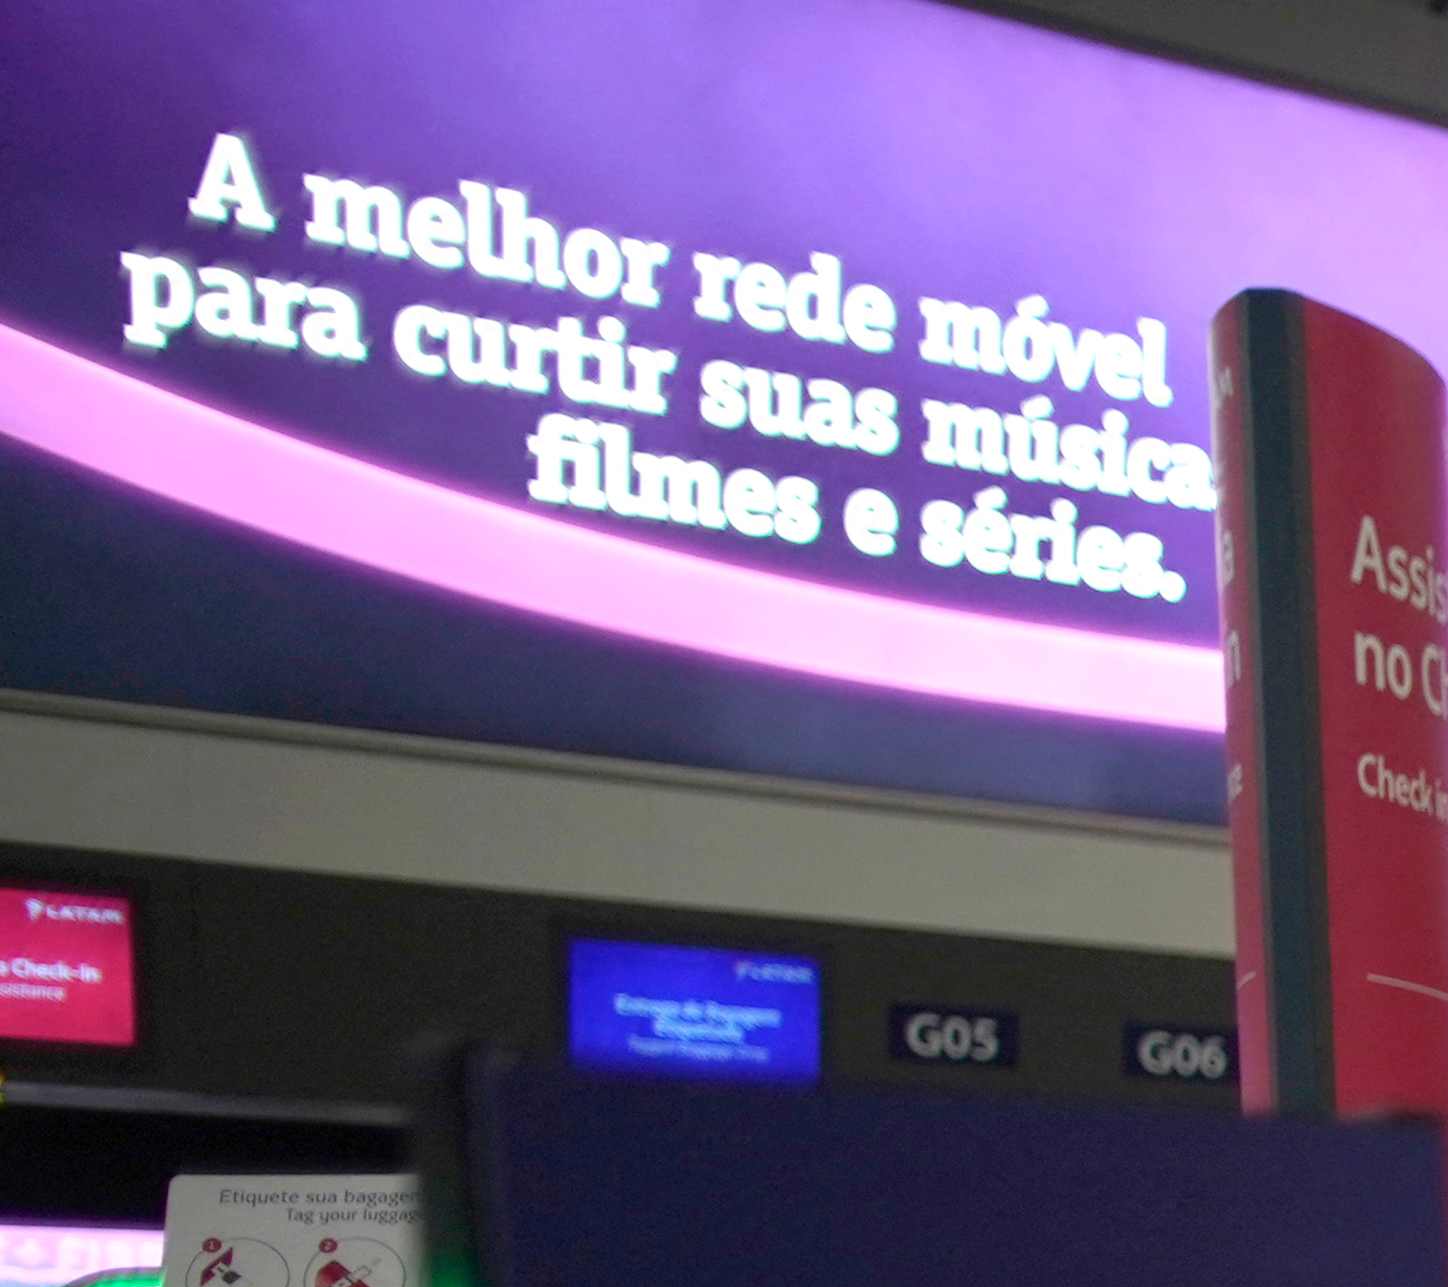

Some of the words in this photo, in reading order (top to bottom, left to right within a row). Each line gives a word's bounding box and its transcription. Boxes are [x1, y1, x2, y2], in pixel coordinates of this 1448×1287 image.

[188, 130, 277, 233] A
[302, 174, 673, 312] melhor
[692, 247, 898, 355] rede
[918, 286, 1175, 409] móvel
[120, 248, 367, 364] para
[392, 302, 678, 417] curtir
[698, 355, 901, 460] suas
[920, 392, 1217, 513] música
[528, 410, 822, 545] filmes
[842, 483, 898, 558] e
[919, 484, 1188, 604] séries.
[1354, 631, 1412, 701] no
[1357, 752, 1432, 817] Check
[905, 1011, 999, 1062] G05
[1137, 1029, 1227, 1079] G06
[219, 1189, 299, 1208] Etiquete
[305, 1193, 338, 1205] sua
[344, 1189, 421, 1208] bagage
[287, 1207, 314, 1225] Tag
[318, 1208, 358, 1224] your
[362, 1207, 422, 1225] luggag
